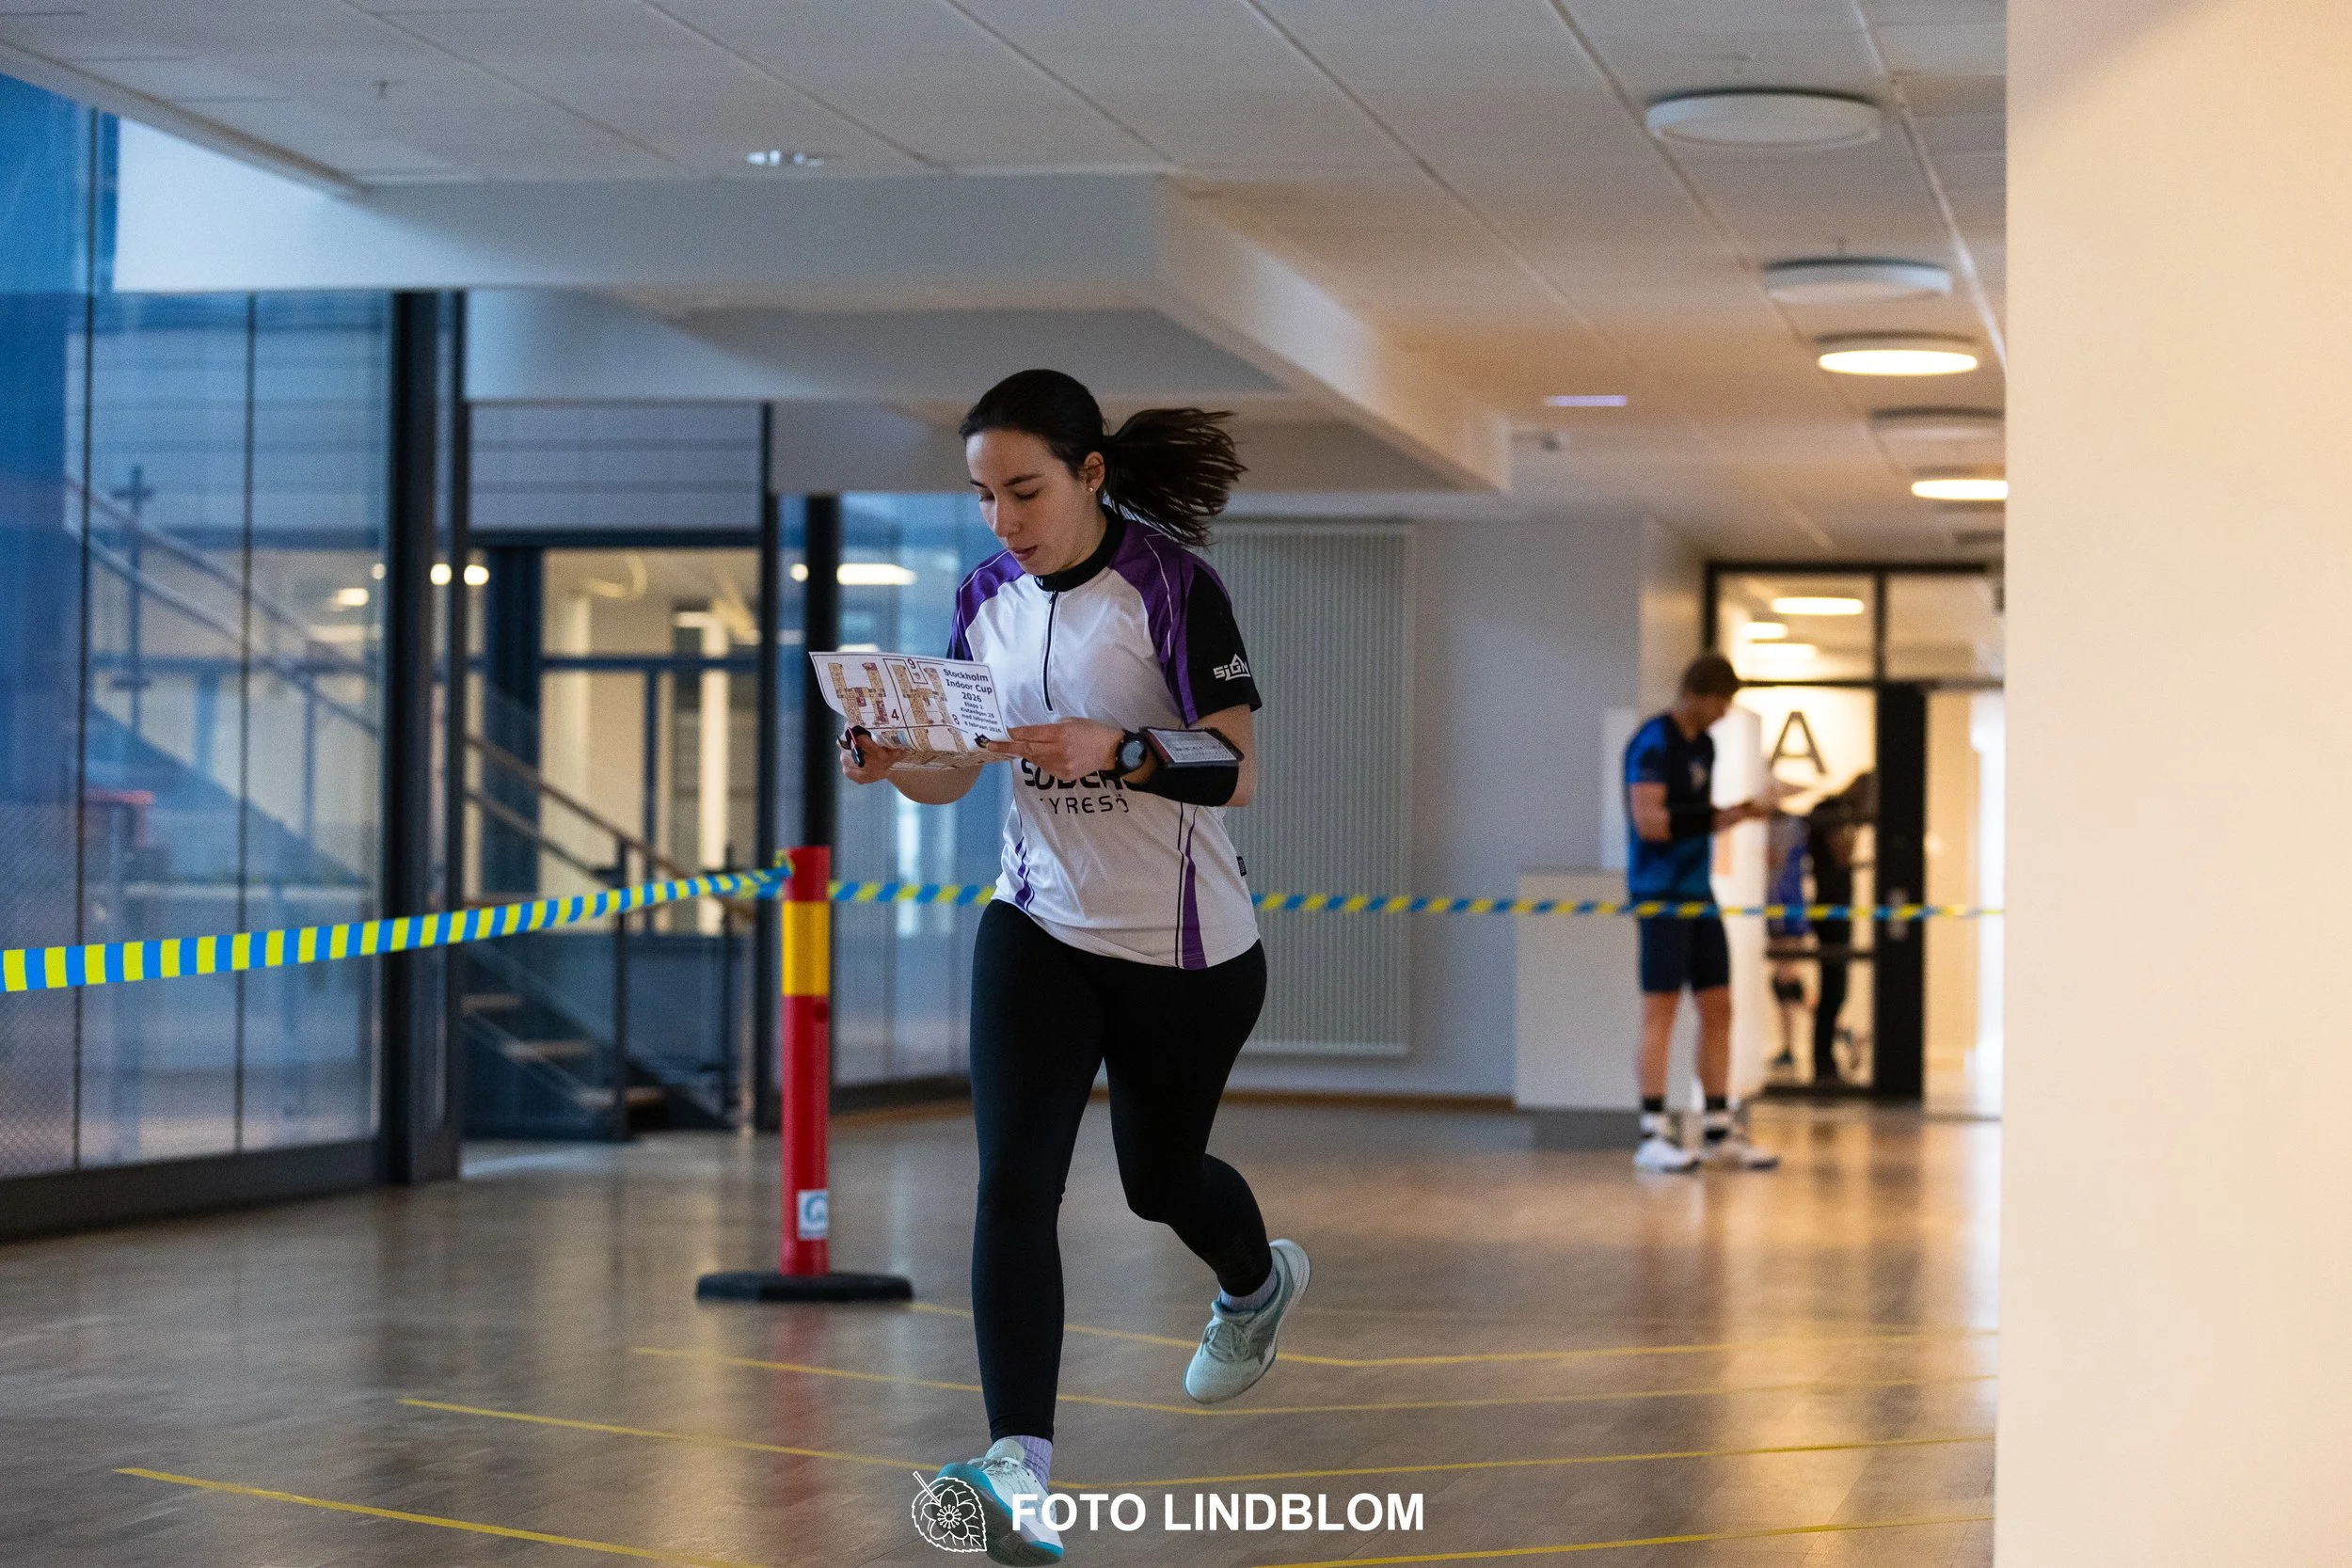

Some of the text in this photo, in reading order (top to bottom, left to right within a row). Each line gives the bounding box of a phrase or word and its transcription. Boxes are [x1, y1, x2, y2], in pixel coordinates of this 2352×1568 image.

[907, 658, 916, 669] 9
[943, 668, 989, 682] Stockholm
[946, 679, 993, 695] Indoor Cup
[961, 691, 982, 703] 2026
[891, 708, 899, 721] 4
[951, 713, 960, 725] 8
[1768, 711, 1826, 774] A
